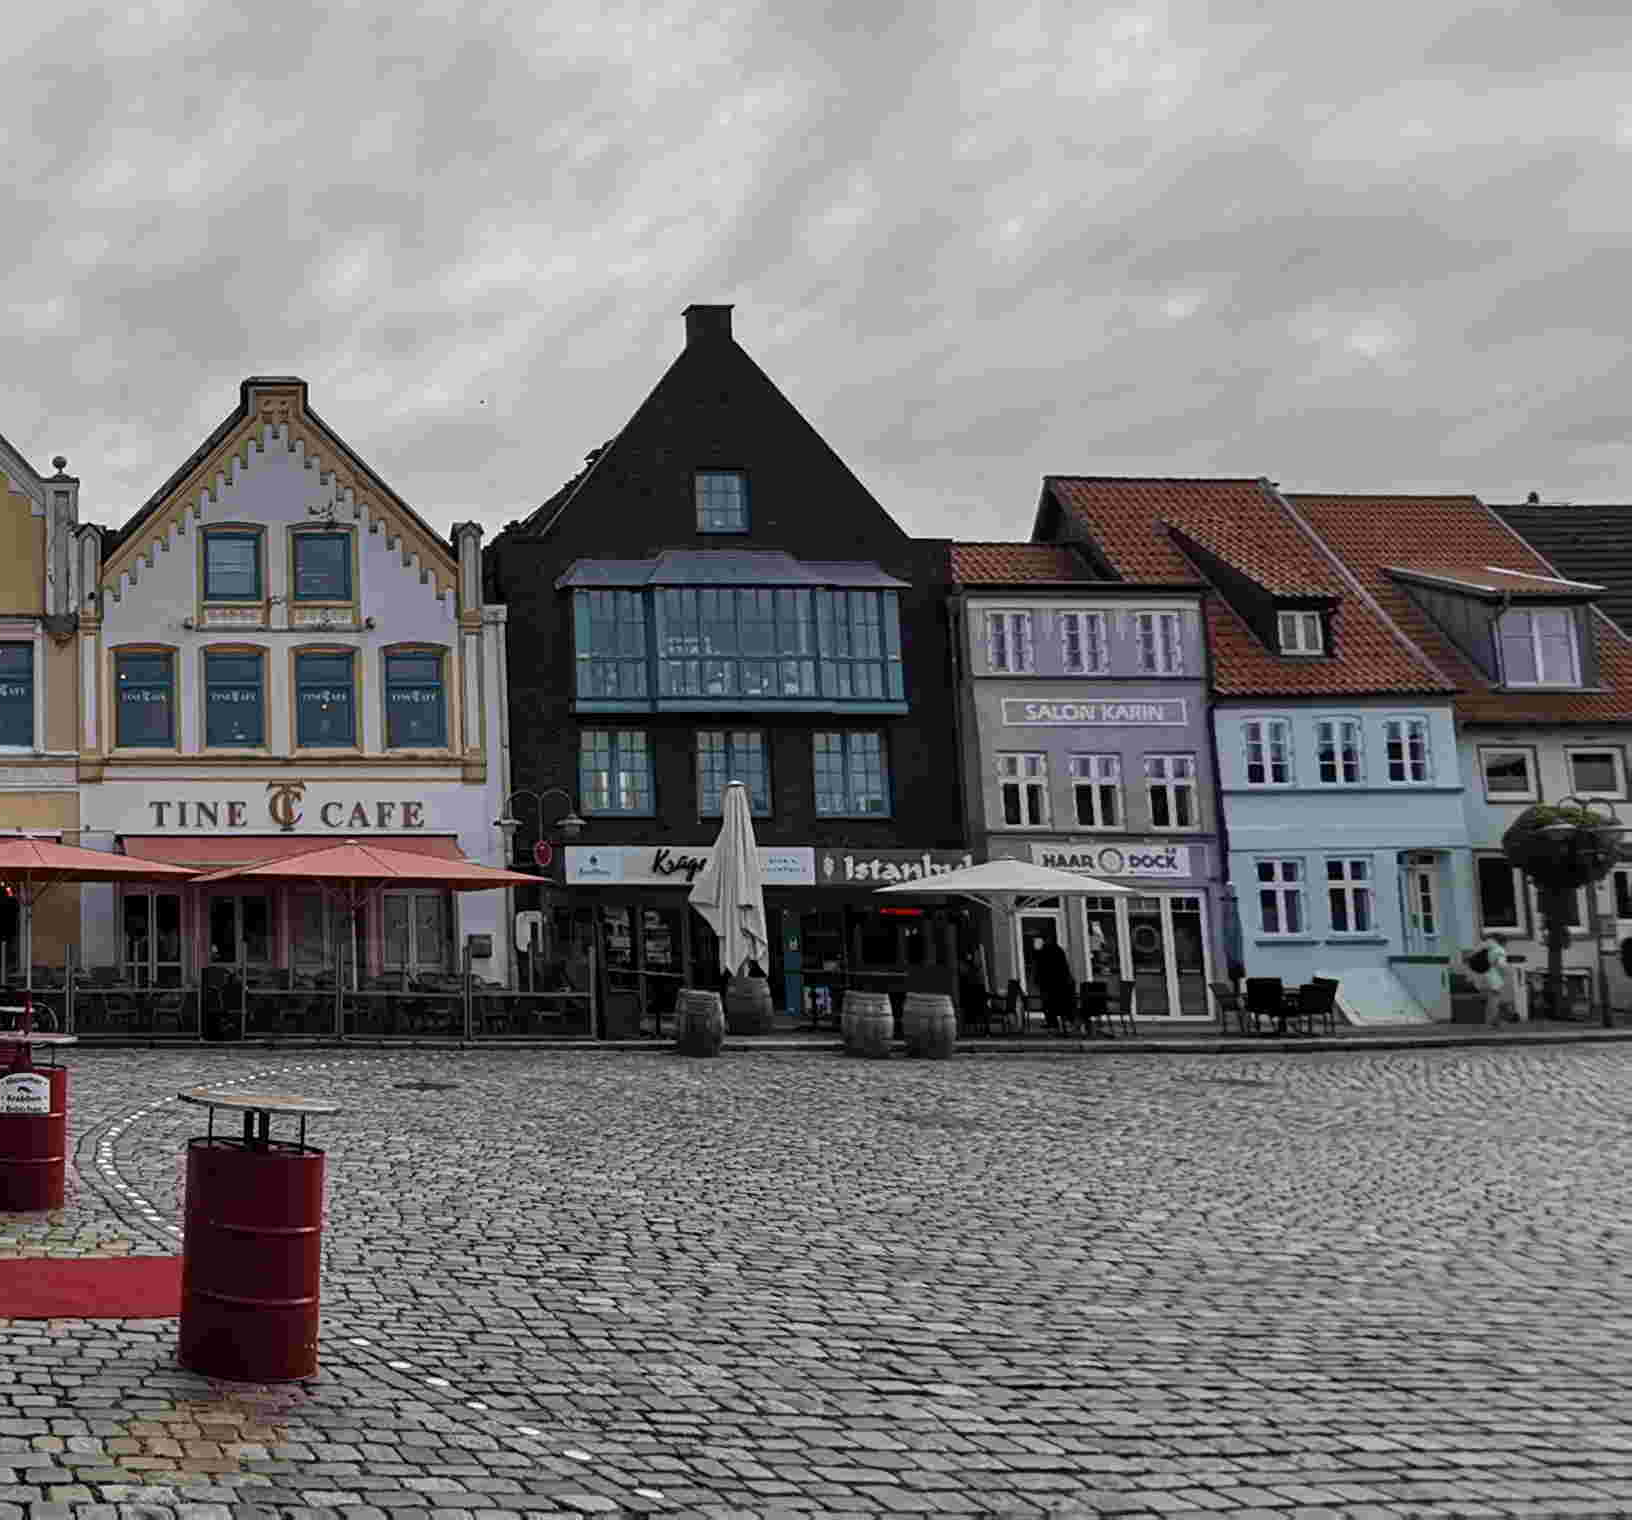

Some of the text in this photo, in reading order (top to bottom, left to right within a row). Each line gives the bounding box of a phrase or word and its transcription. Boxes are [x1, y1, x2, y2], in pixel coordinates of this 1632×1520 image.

[1024, 703, 1164, 721] SALON KARIN
[148, 800, 248, 828] TINE
[320, 800, 425, 828] CAFE
[1041, 853, 1178, 870] HAAR DOCK
